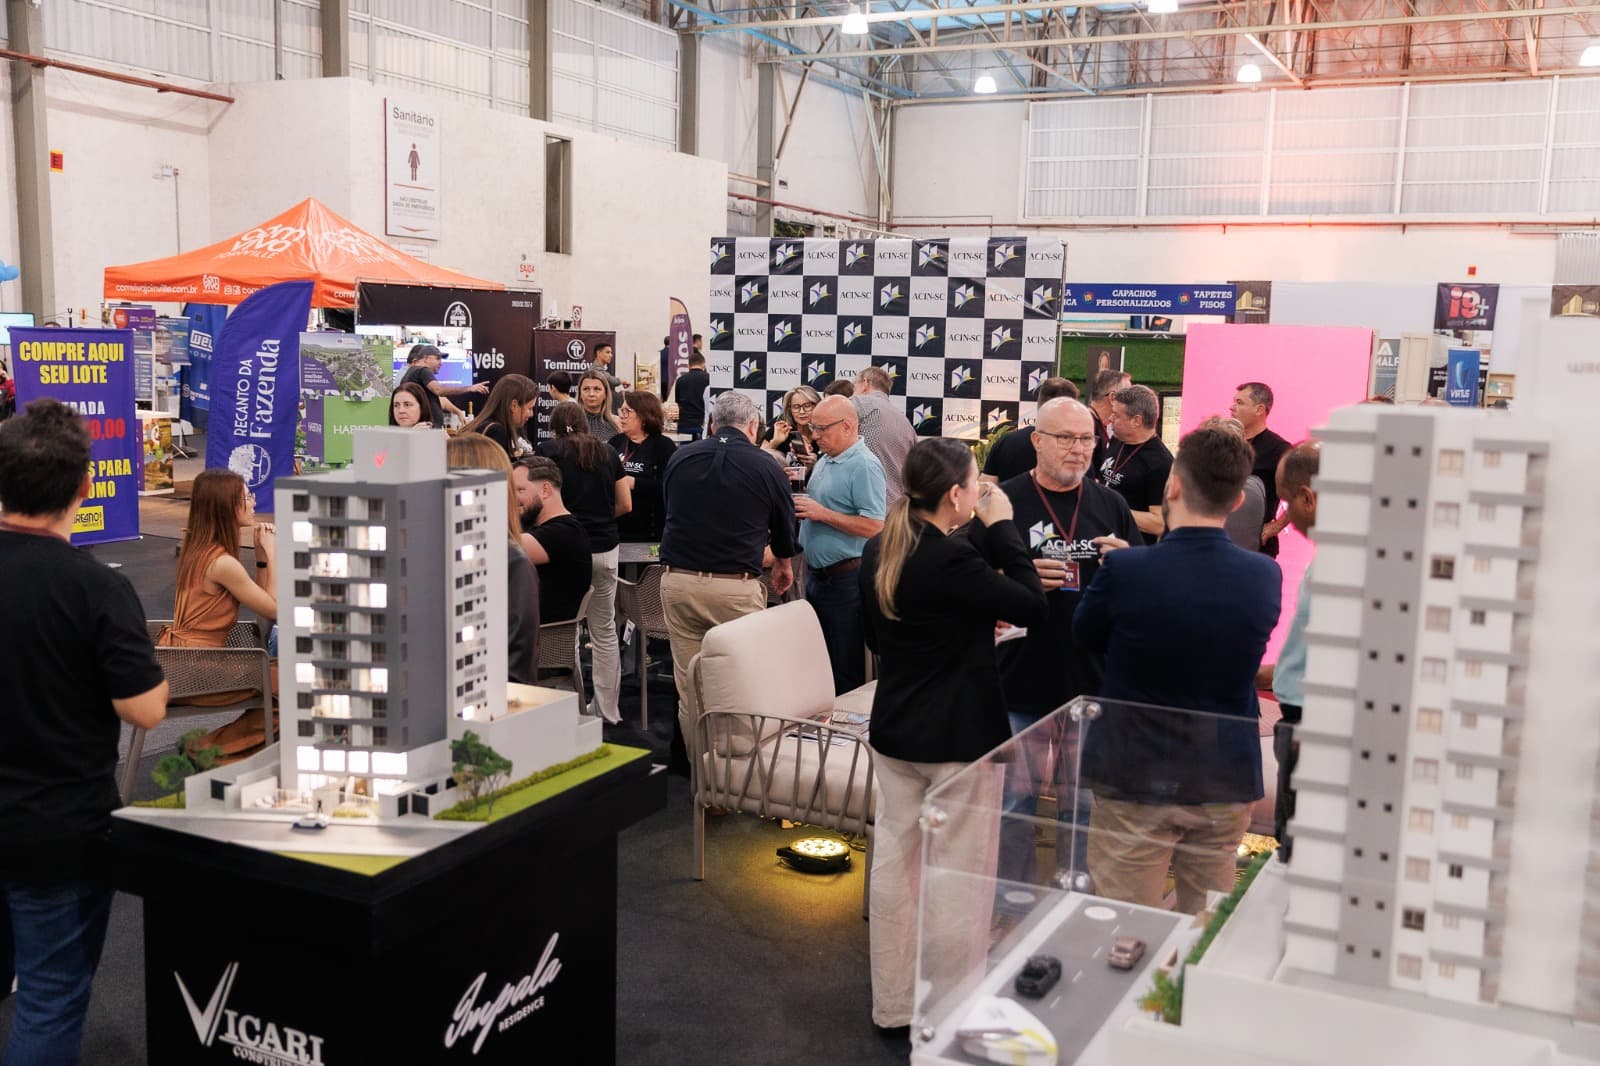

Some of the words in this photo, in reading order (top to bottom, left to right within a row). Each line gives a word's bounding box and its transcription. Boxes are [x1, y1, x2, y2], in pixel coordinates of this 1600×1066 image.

[393, 107, 434, 127] Sanitário
[770, 290, 800, 299] ACIN-SC
[840, 291, 871, 299] ACIN-SC
[912, 292, 945, 301] ACIN-SC
[1112, 289, 1157, 298] CAPACHOS
[1194, 290, 1233, 299] TAPETES
[1096, 299, 1172, 308] PERSONALIZADOS
[1200, 301, 1226, 309] PISOS
[736, 328, 766, 336] ACIN-SC
[805, 329, 834, 338] ACIN-SC
[874, 331, 905, 340] ACIN-SC
[949, 333, 982, 342] ACIN-SC
[20, 341, 85, 361] COMPRE
[88, 343, 124, 363] AQUI
[239, 359, 253, 376] DA
[543, 359, 593, 371] Temimóv
[40, 365, 69, 384] SEU
[73, 365, 108, 384] LOTE
[769, 367, 799, 376] ACIN-SC
[909, 372, 942, 381] ACIN-SC
[984, 375, 1018, 384] ACIN-SC
[250, 339, 281, 439] Fazenda
[538, 397, 560, 409] Pagam
[234, 381, 251, 436] RECANTO
[944, 414, 979, 423] ACIN-SC
[98, 459, 132, 477] PARA
[445, 932, 562, 1055] Impala
[174, 961, 324, 1066] VICARI
[498, 996, 545, 1032] RESIDENCE
